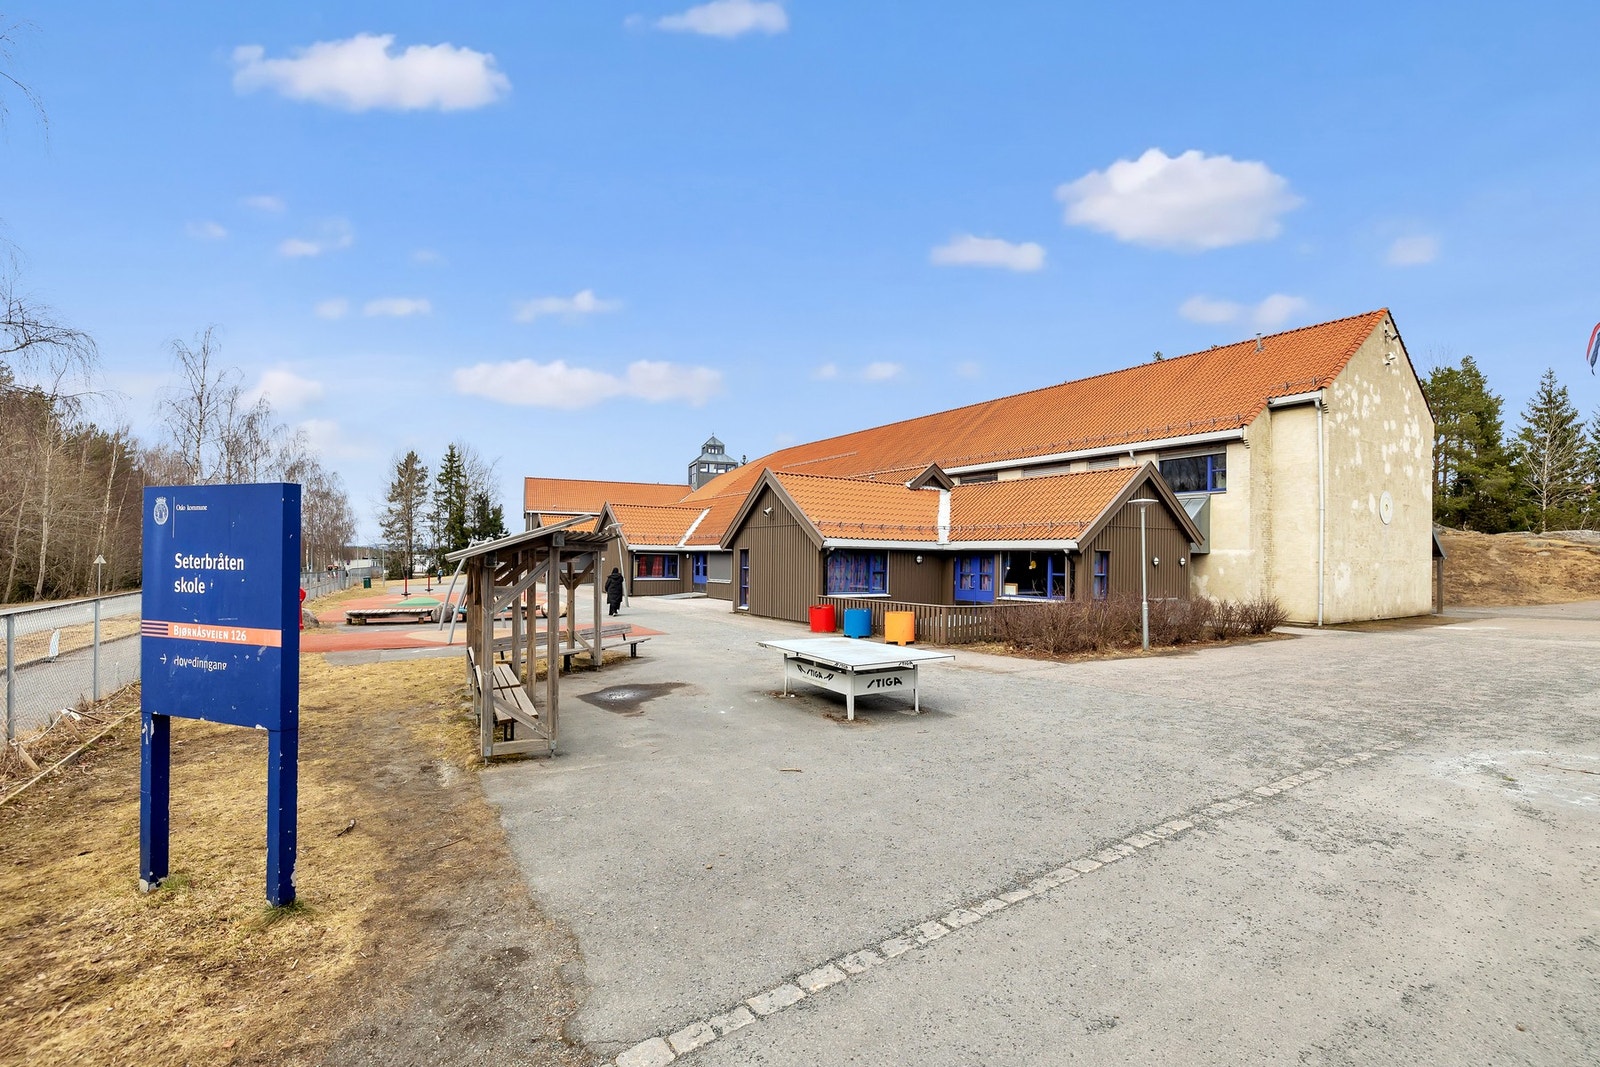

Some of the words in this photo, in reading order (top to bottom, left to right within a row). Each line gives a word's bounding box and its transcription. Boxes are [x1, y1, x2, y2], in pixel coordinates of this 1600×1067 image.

[174, 552, 244, 571] Seterbråten
[174, 576, 206, 594] skole
[231, 629, 247, 641] 126
[867, 677, 903, 688] STIGA
